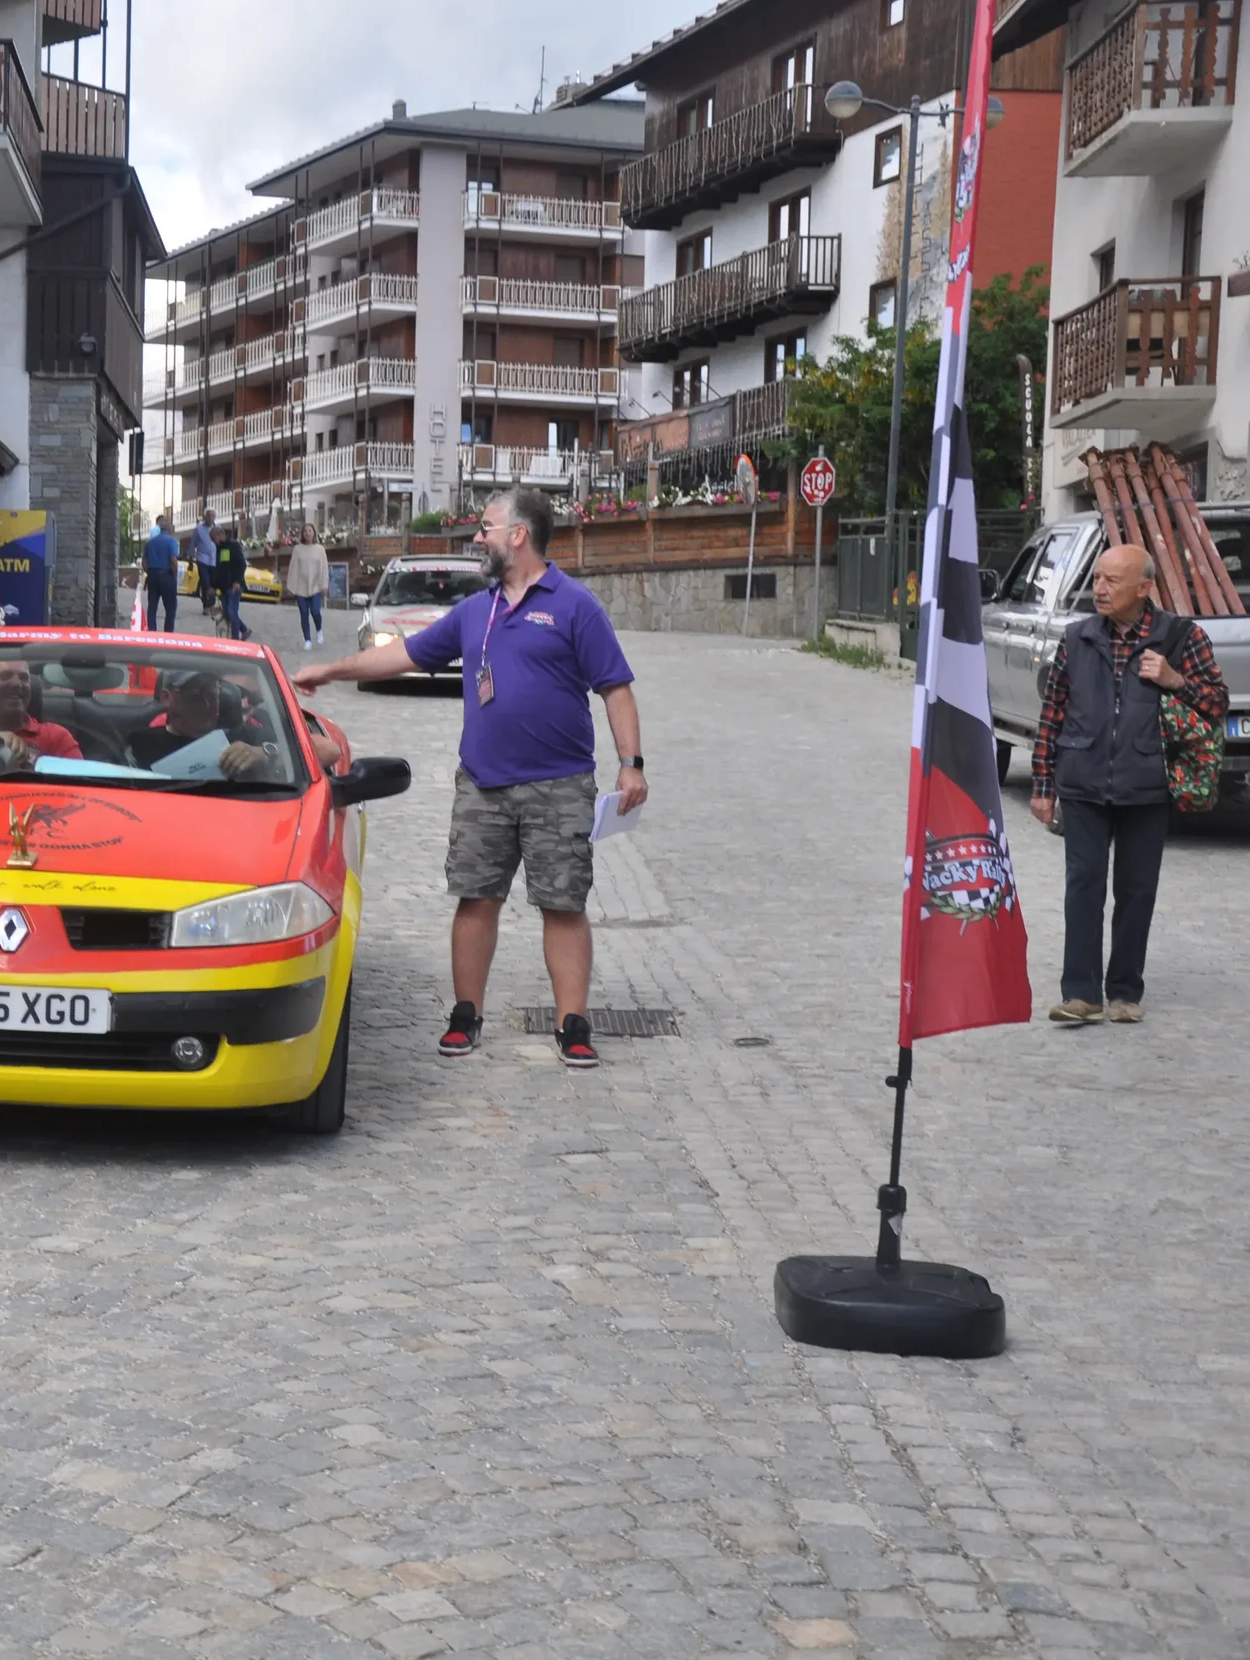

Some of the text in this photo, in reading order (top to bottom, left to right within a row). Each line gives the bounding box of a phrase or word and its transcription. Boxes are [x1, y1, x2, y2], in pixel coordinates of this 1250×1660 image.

[1024, 372, 1034, 448] SCUOLA
[429, 402, 447, 493] HOTEL
[803, 472, 833, 492] STOP
[20, 992, 90, 1026] XGO
